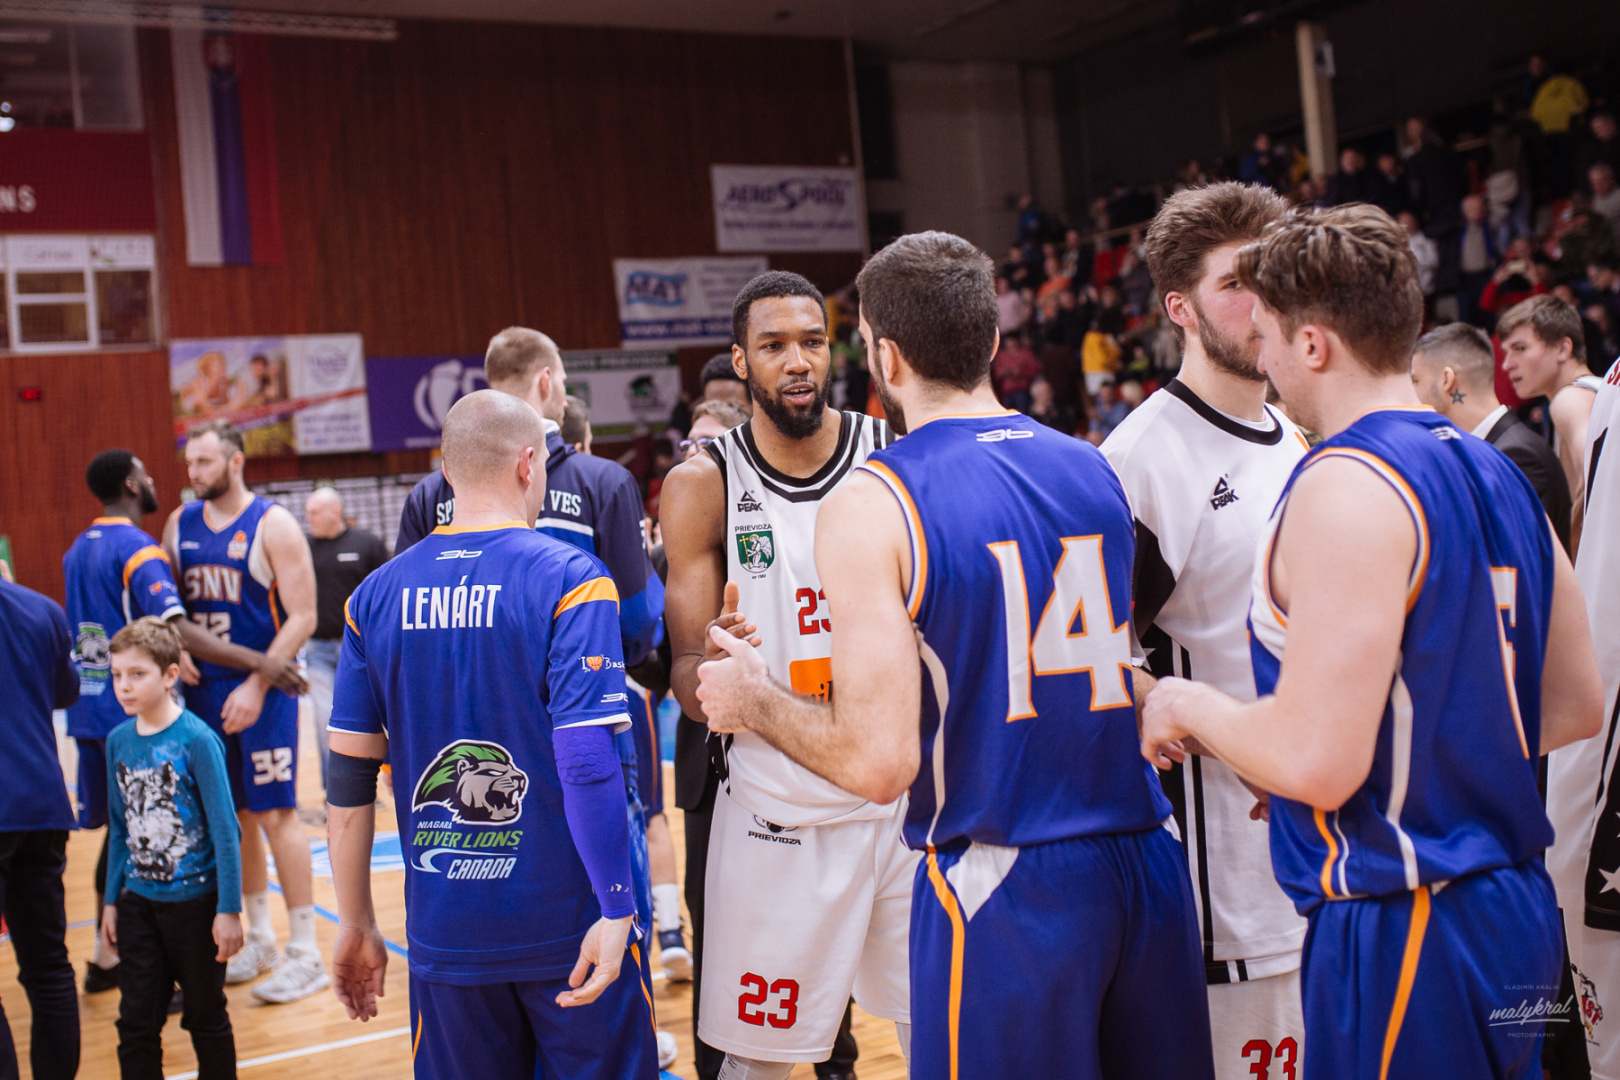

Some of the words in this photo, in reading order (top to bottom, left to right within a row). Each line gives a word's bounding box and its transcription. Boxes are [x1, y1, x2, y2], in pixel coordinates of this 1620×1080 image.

[550, 489, 582, 517] VES
[737, 502, 763, 512] PEAK
[1210, 488, 1239, 511] PEAK
[734, 523, 773, 532] PRIEVIDZA
[184, 564, 243, 605] SNV
[402, 574, 502, 631] LENÁRT
[986, 534, 1133, 723] 14
[250, 746, 293, 786] 32
[416, 820, 453, 829] NIAGARA
[413, 830, 463, 848] RIVER
[461, 830, 524, 848] LIONS
[748, 830, 802, 846] PRIEVIDZA
[446, 857, 518, 880] CANADA
[738, 972, 799, 1029] 23
[1241, 1036, 1298, 1080] 33
